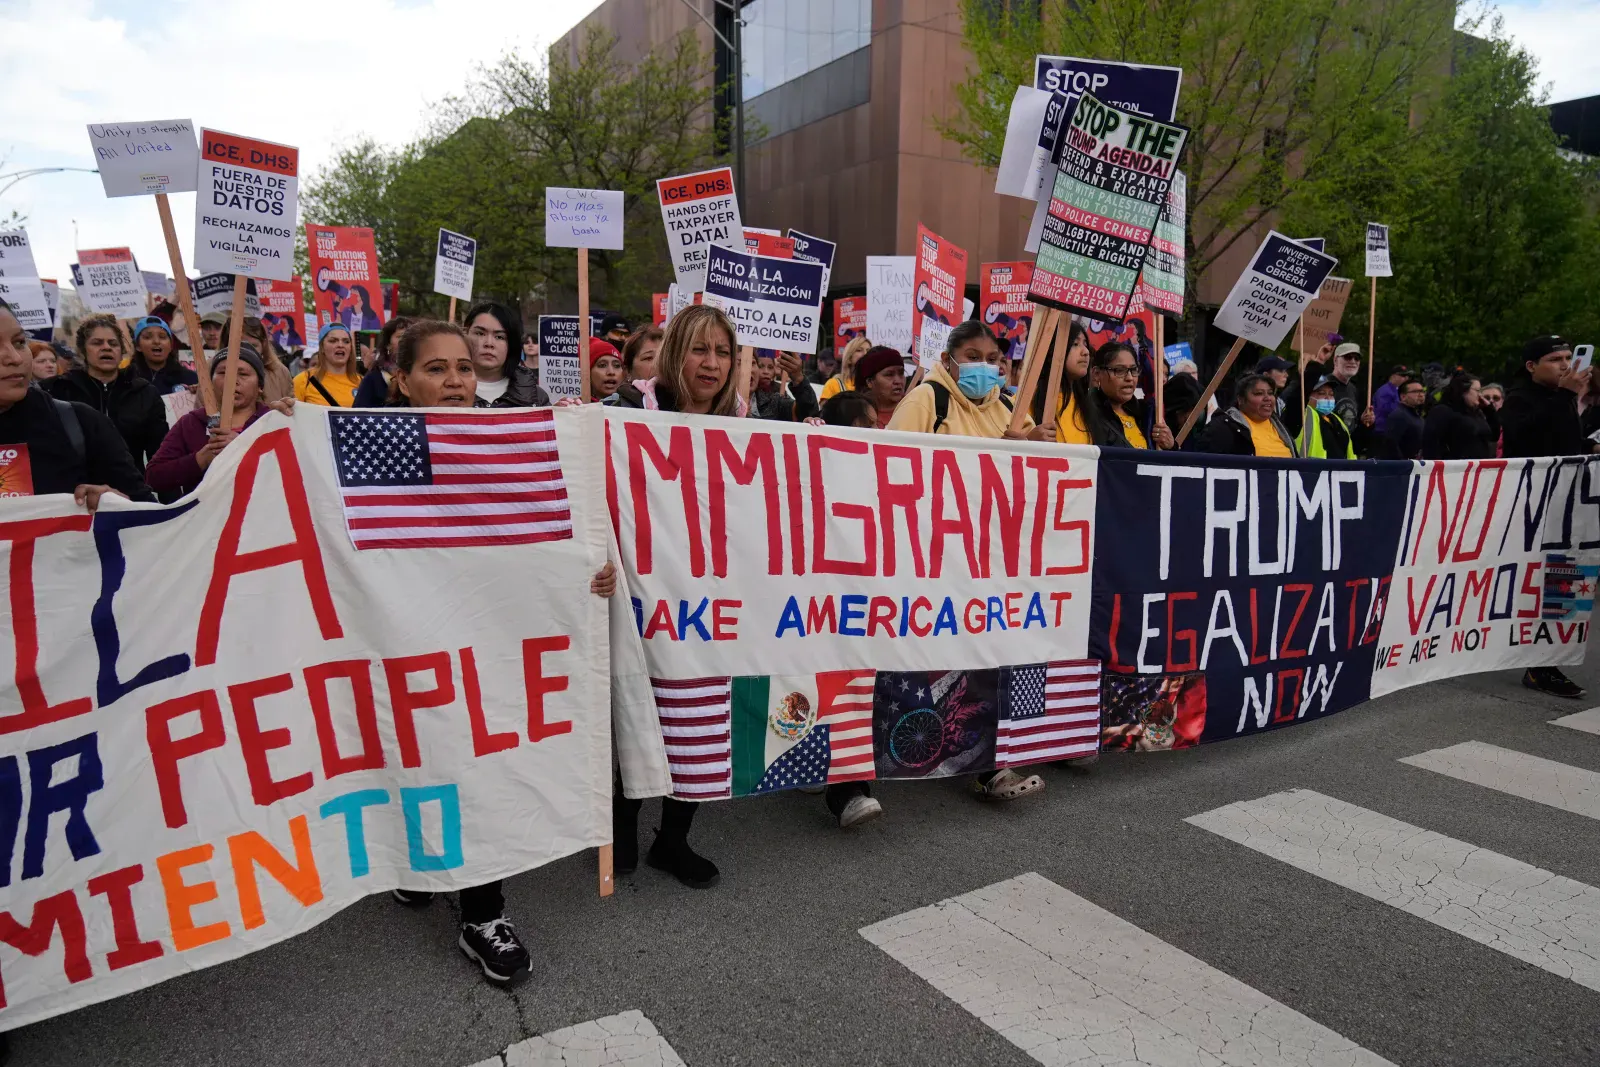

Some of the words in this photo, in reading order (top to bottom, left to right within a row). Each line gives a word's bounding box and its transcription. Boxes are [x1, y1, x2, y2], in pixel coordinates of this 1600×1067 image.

[1044, 68, 1109, 93] STOP
[1047, 101, 1061, 125] ST
[91, 125, 132, 139] Unity
[1073, 95, 1121, 140] STOP
[1126, 117, 1181, 160] THE
[98, 146, 119, 161] All
[125, 142, 173, 157] United
[207, 140, 245, 163] ICE,
[250, 150, 294, 171] DHS:
[1067, 125, 1098, 155] TRUMP
[1097, 142, 1172, 179] AGENDA!
[212, 166, 260, 185] FUERA
[267, 177, 287, 190] DE
[1062, 146, 1091, 169] DEFEND
[1095, 162, 1103, 175] &
[1110, 167, 1168, 193] EXPAND
[213, 179, 285, 201] NUESTRO
[663, 186, 692, 200] ICE,
[695, 179, 730, 197] DHS:
[1060, 158, 1107, 188] IMMIGRANT
[1112, 181, 1164, 205] RIGHTS
[213, 191, 284, 216] DATOS
[550, 200, 568, 210] No
[1055, 173, 1074, 188] STAND
[1075, 180, 1096, 200] WITH
[1097, 191, 1157, 217] PALESTINE
[550, 213, 587, 223] Abuso
[667, 203, 706, 218] HANDS
[709, 200, 731, 211] OFF
[1074, 195, 1090, 209] AID
[1094, 202, 1108, 215] TO
[1112, 210, 1152, 230] ISRAEL
[202, 216, 291, 238] RECHAZAMOS
[669, 211, 735, 232] TAXPAYER
[1050, 199, 1064, 215] STOP
[1065, 208, 1099, 228] POLICE
[1103, 220, 1150, 242] CRIMES
[239, 234, 254, 243] LA
[317, 239, 337, 250] STOP
[681, 226, 729, 246] DATA!
[1045, 215, 1066, 233] DEFEND
[1066, 225, 1117, 248] LGBTQIA+
[1119, 242, 1145, 257] AND
[209, 240, 281, 259] VIGILANCIA
[318, 249, 367, 260] DEPORTATIONS
[922, 243, 938, 265] STOP
[1042, 228, 1095, 257] REPRODUCTIVE
[1098, 249, 1141, 269] RIGHTS
[1278, 245, 1320, 266] ¡INVIERTE
[87, 265, 115, 273] FUERA
[90, 270, 130, 279] NUESTRO
[320, 270, 370, 281] IMMIGRANTS
[334, 260, 368, 271] DEFEND
[679, 262, 707, 273] SURVE
[711, 257, 745, 277] ¡ALTO
[748, 267, 759, 279] A
[763, 268, 783, 283] LA
[921, 257, 956, 287] DEPORTATIONS
[1088, 260, 1120, 277] RIGHTS
[1123, 270, 1136, 282] TO
[1265, 265, 1308, 288] OBRERA!
[1275, 260, 1308, 277] CLASE
[92, 276, 131, 287] DATOS
[197, 276, 228, 290] STOP
[709, 272, 812, 300] CRIMINALIZACIÓN!
[932, 276, 955, 303] DEFEND
[991, 275, 1012, 285] STOP
[991, 284, 1030, 293] DEPORTATIO
[1033, 268, 1052, 285] DEFEND
[1052, 277, 1114, 303] EDUCATION
[1118, 295, 1127, 306] &
[1071, 267, 1079, 279] &
[1086, 271, 1133, 293] STRIKE
[1250, 276, 1305, 304] PAGAMOS
[1322, 279, 1348, 294] GHT
[90, 288, 138, 298] RECHAZAMOS
[920, 284, 955, 314] IMMIGRANTS
[1007, 293, 1029, 303] DEFE
[1029, 280, 1061, 300] ACADEMIC
[1065, 292, 1124, 317] FREEDOM
[1251, 289, 1288, 311] CUOTA.
[97, 301, 138, 310] VIGILANCIA
[1237, 299, 1271, 317] ¡PAGA
[1272, 310, 1287, 323] LA
[1311, 307, 1332, 320] NOT
[724, 306, 764, 322] ¡ALTO
[768, 312, 780, 325] A
[782, 316, 812, 328] LAS
[1242, 310, 1272, 328] TUYA!
[544, 335, 579, 345] WORKIN
[732, 322, 811, 343] ORTACIONES!
[546, 359, 561, 368] WE
[1136, 464, 1365, 580] TRUMP
[1407, 562, 1542, 637] VAMOS
[775, 594, 957, 638] AMERICA
[963, 592, 1072, 635] GREAT
[1375, 643, 1404, 672] WE
[1409, 635, 1441, 664] ARE
[1451, 627, 1491, 654] NOT
[1236, 661, 1344, 734] NOW
[145, 635, 572, 829] PEOPLE
